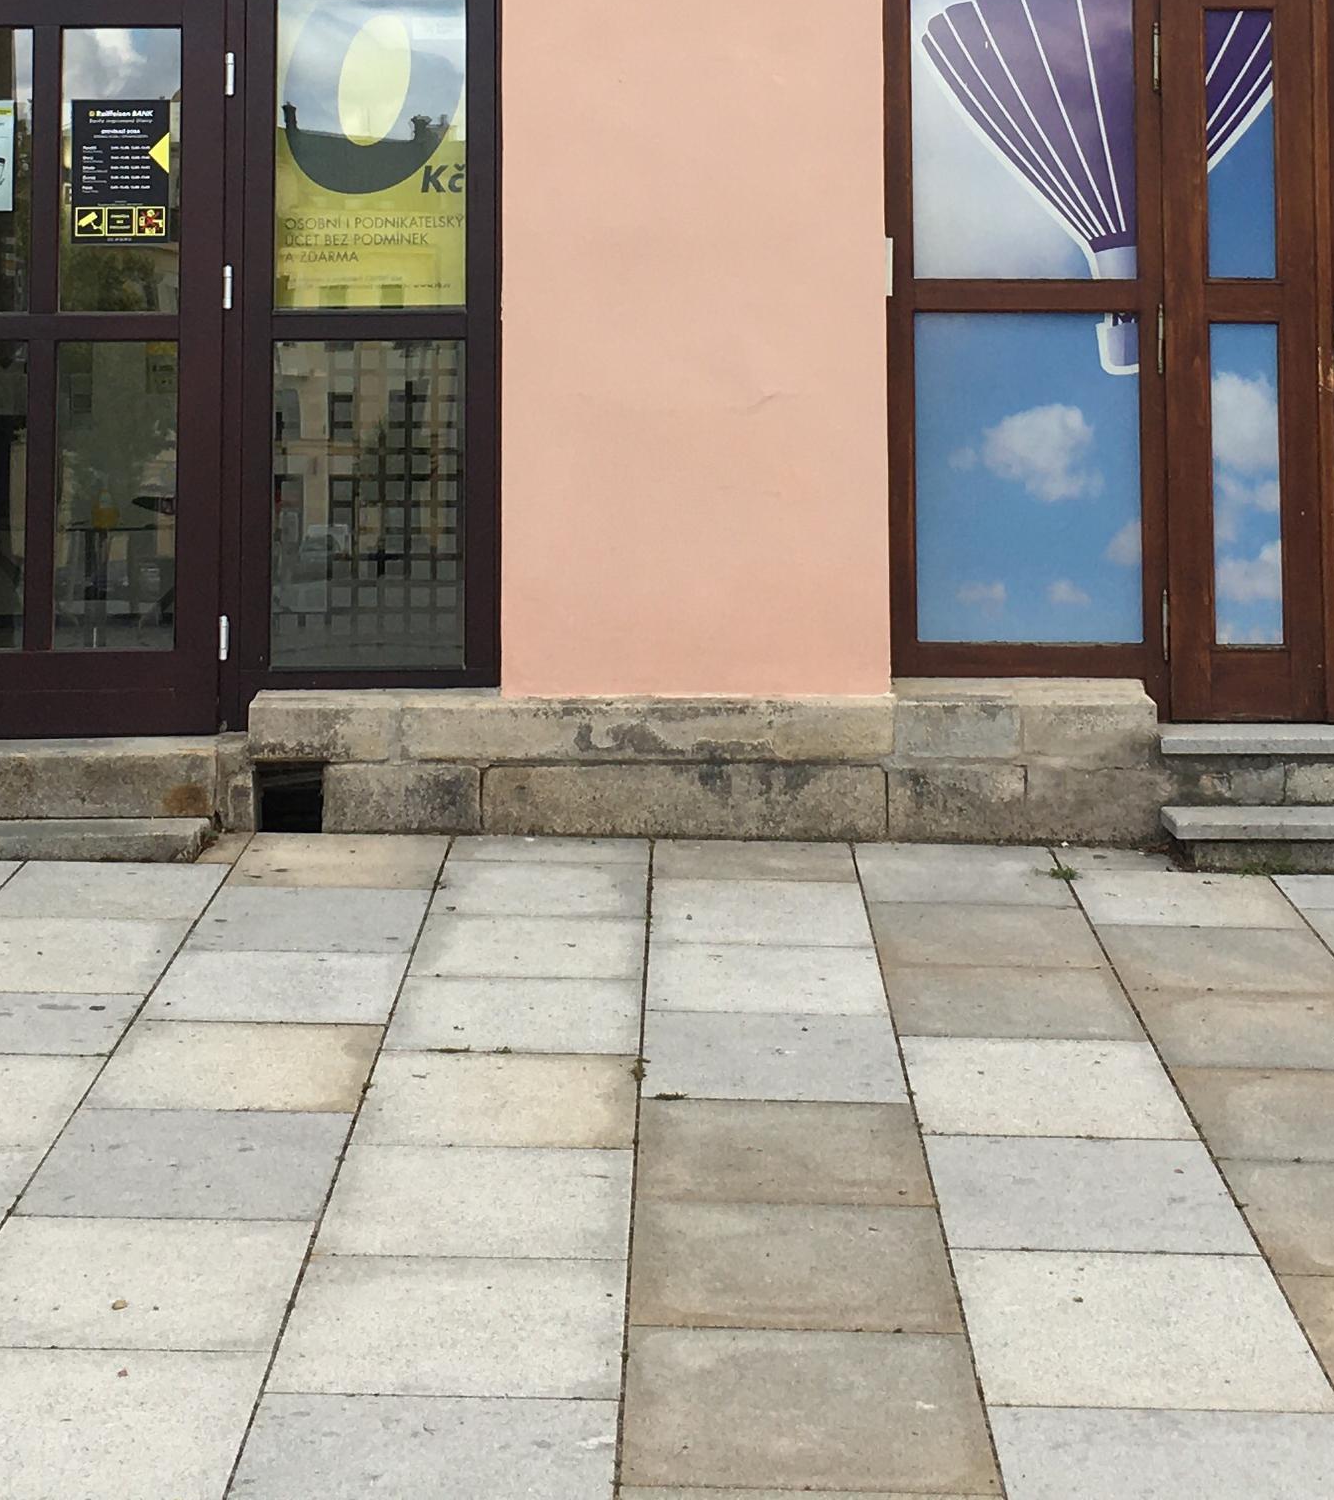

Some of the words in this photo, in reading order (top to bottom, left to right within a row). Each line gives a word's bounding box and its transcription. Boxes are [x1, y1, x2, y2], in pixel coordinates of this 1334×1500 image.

[421, 164, 465, 193] Kč
[284, 215, 341, 231] OSOBNÍ
[354, 213, 464, 229] PODNIKATELSKÝ
[324, 233, 349, 246] BEZ
[354, 231, 428, 246] PODMÍNEK
[285, 251, 293, 262] A
[300, 250, 359, 263] ZDARMA
